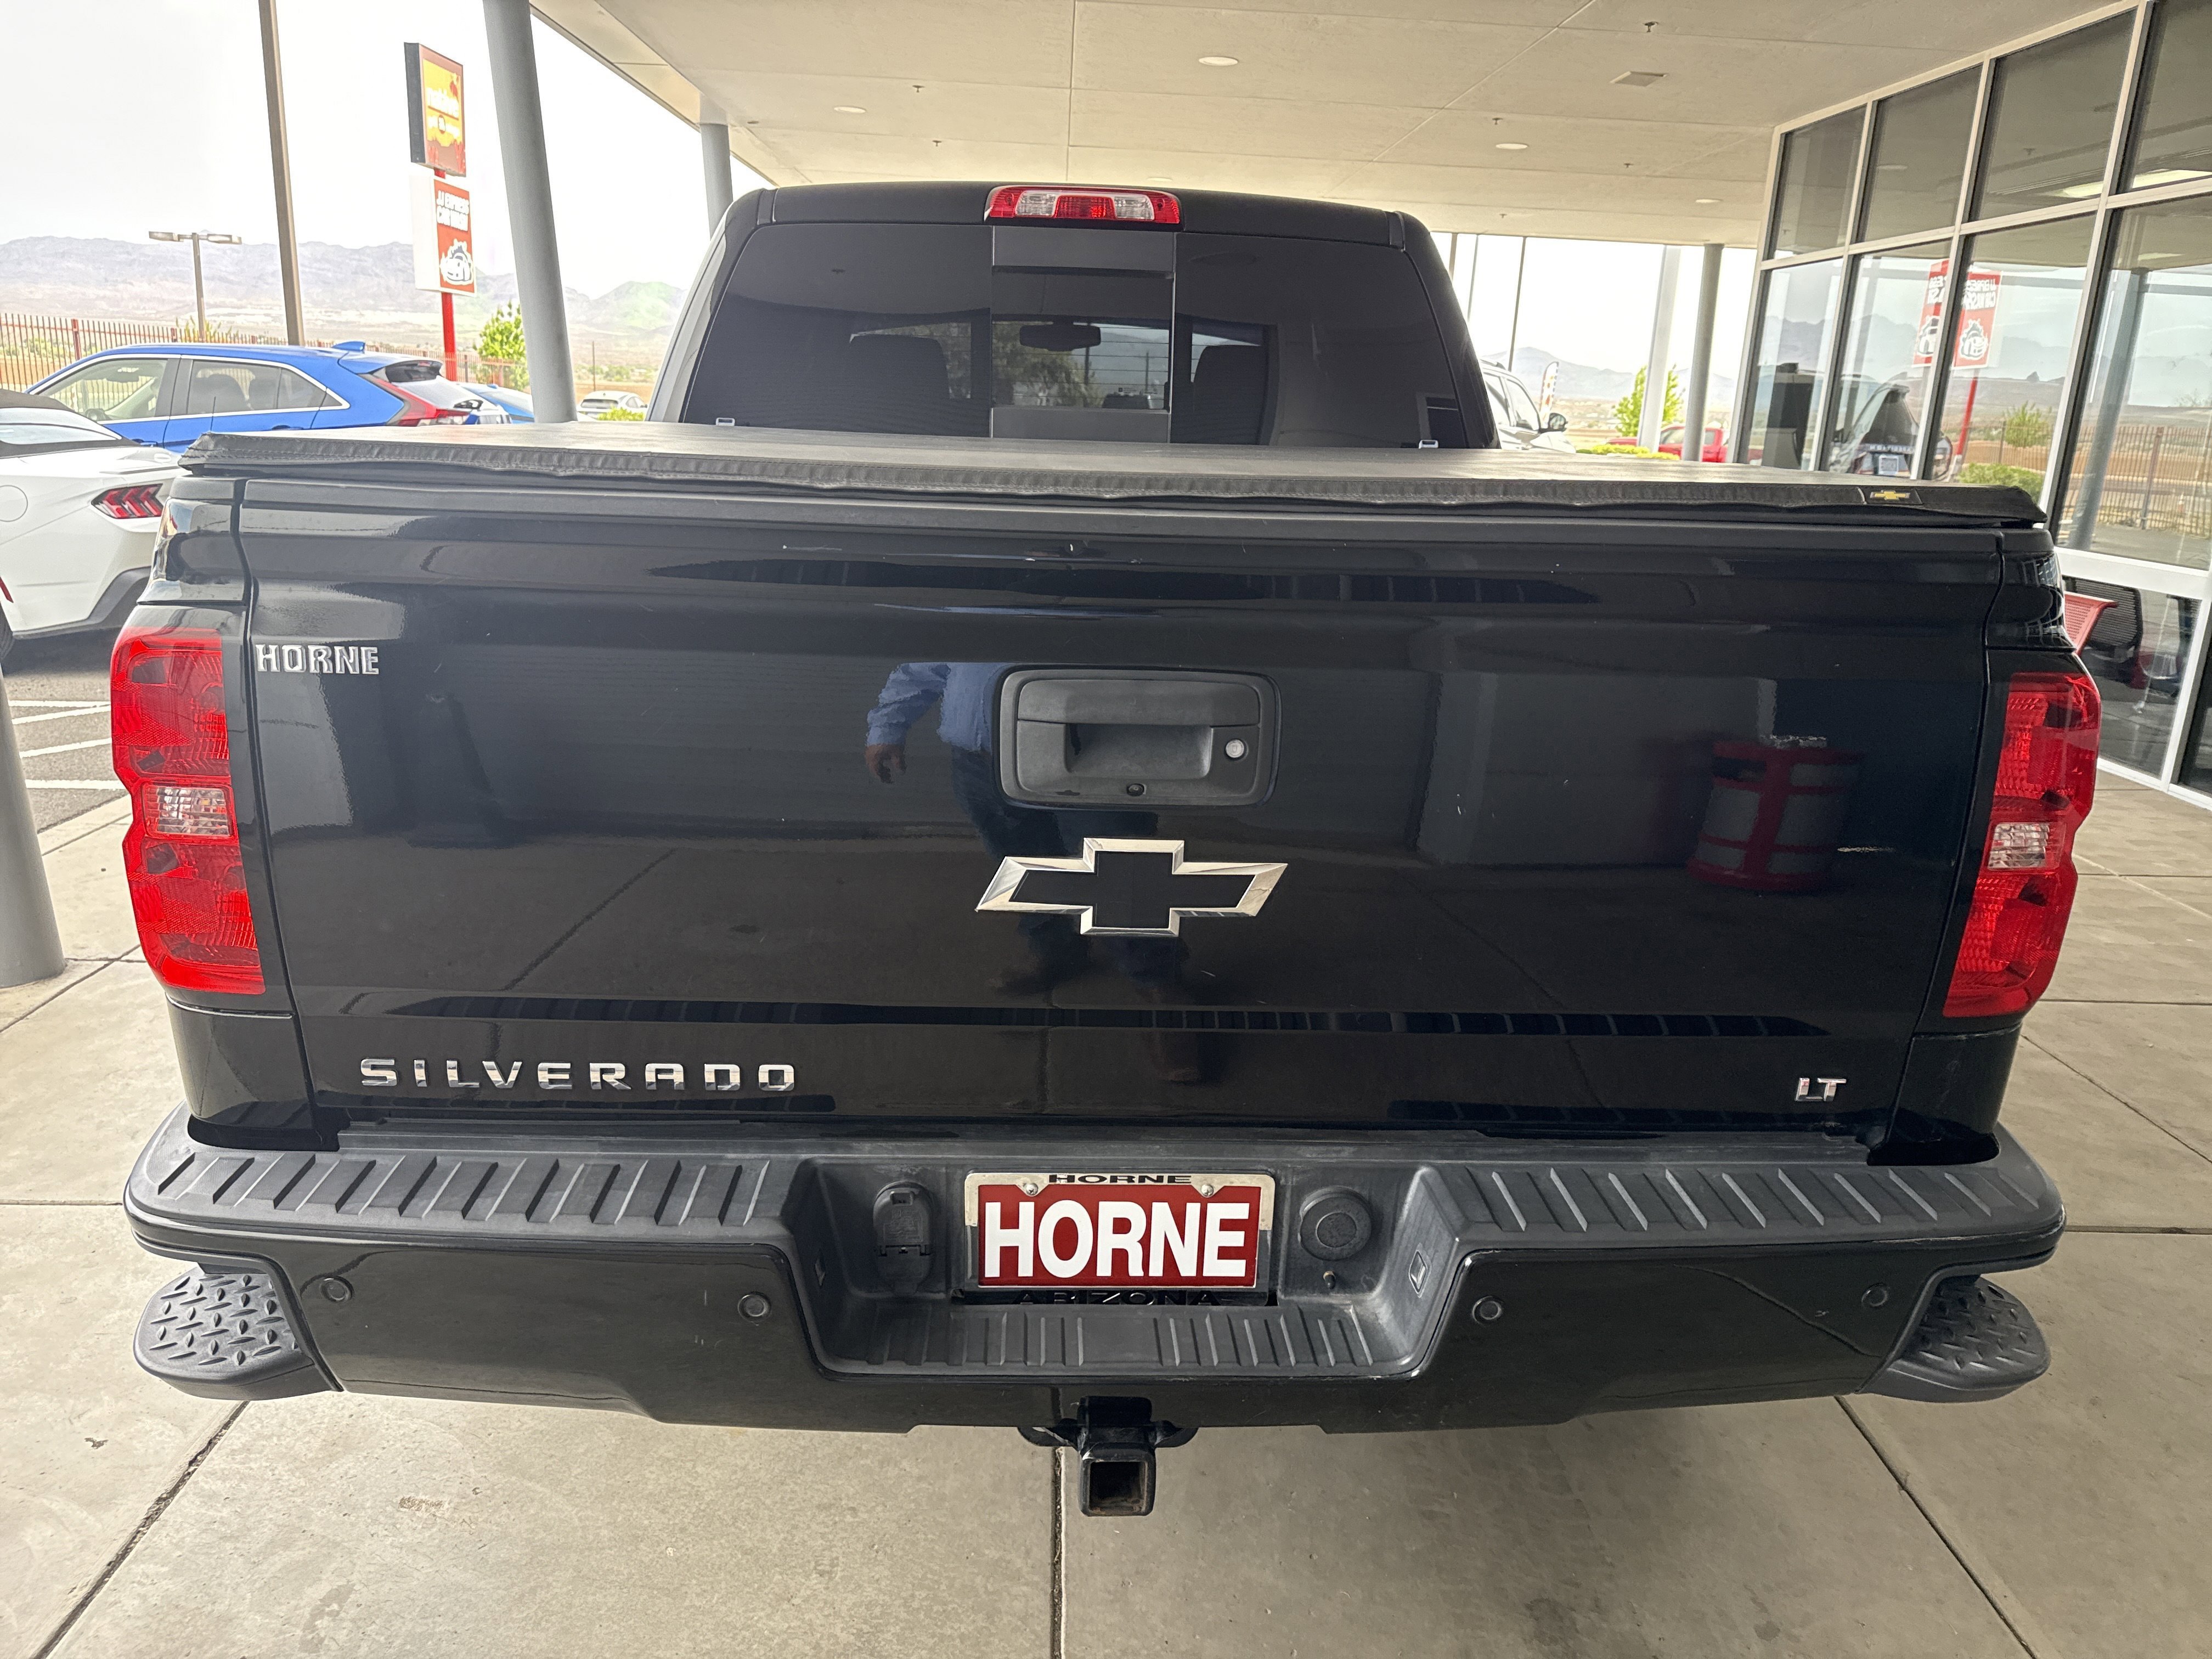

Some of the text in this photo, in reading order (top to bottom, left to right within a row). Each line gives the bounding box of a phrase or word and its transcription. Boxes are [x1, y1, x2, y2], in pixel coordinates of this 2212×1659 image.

[436, 190, 469, 215] JJ EXPRESS
[437, 205, 468, 232] CAR WASH
[255, 644, 380, 675] HORNE
[360, 1058, 795, 1092] SILVERADO
[1795, 1077, 1847, 1102] LT
[1048, 1174, 1192, 1184] HORNE
[985, 1200, 1250, 1278] HORNE
